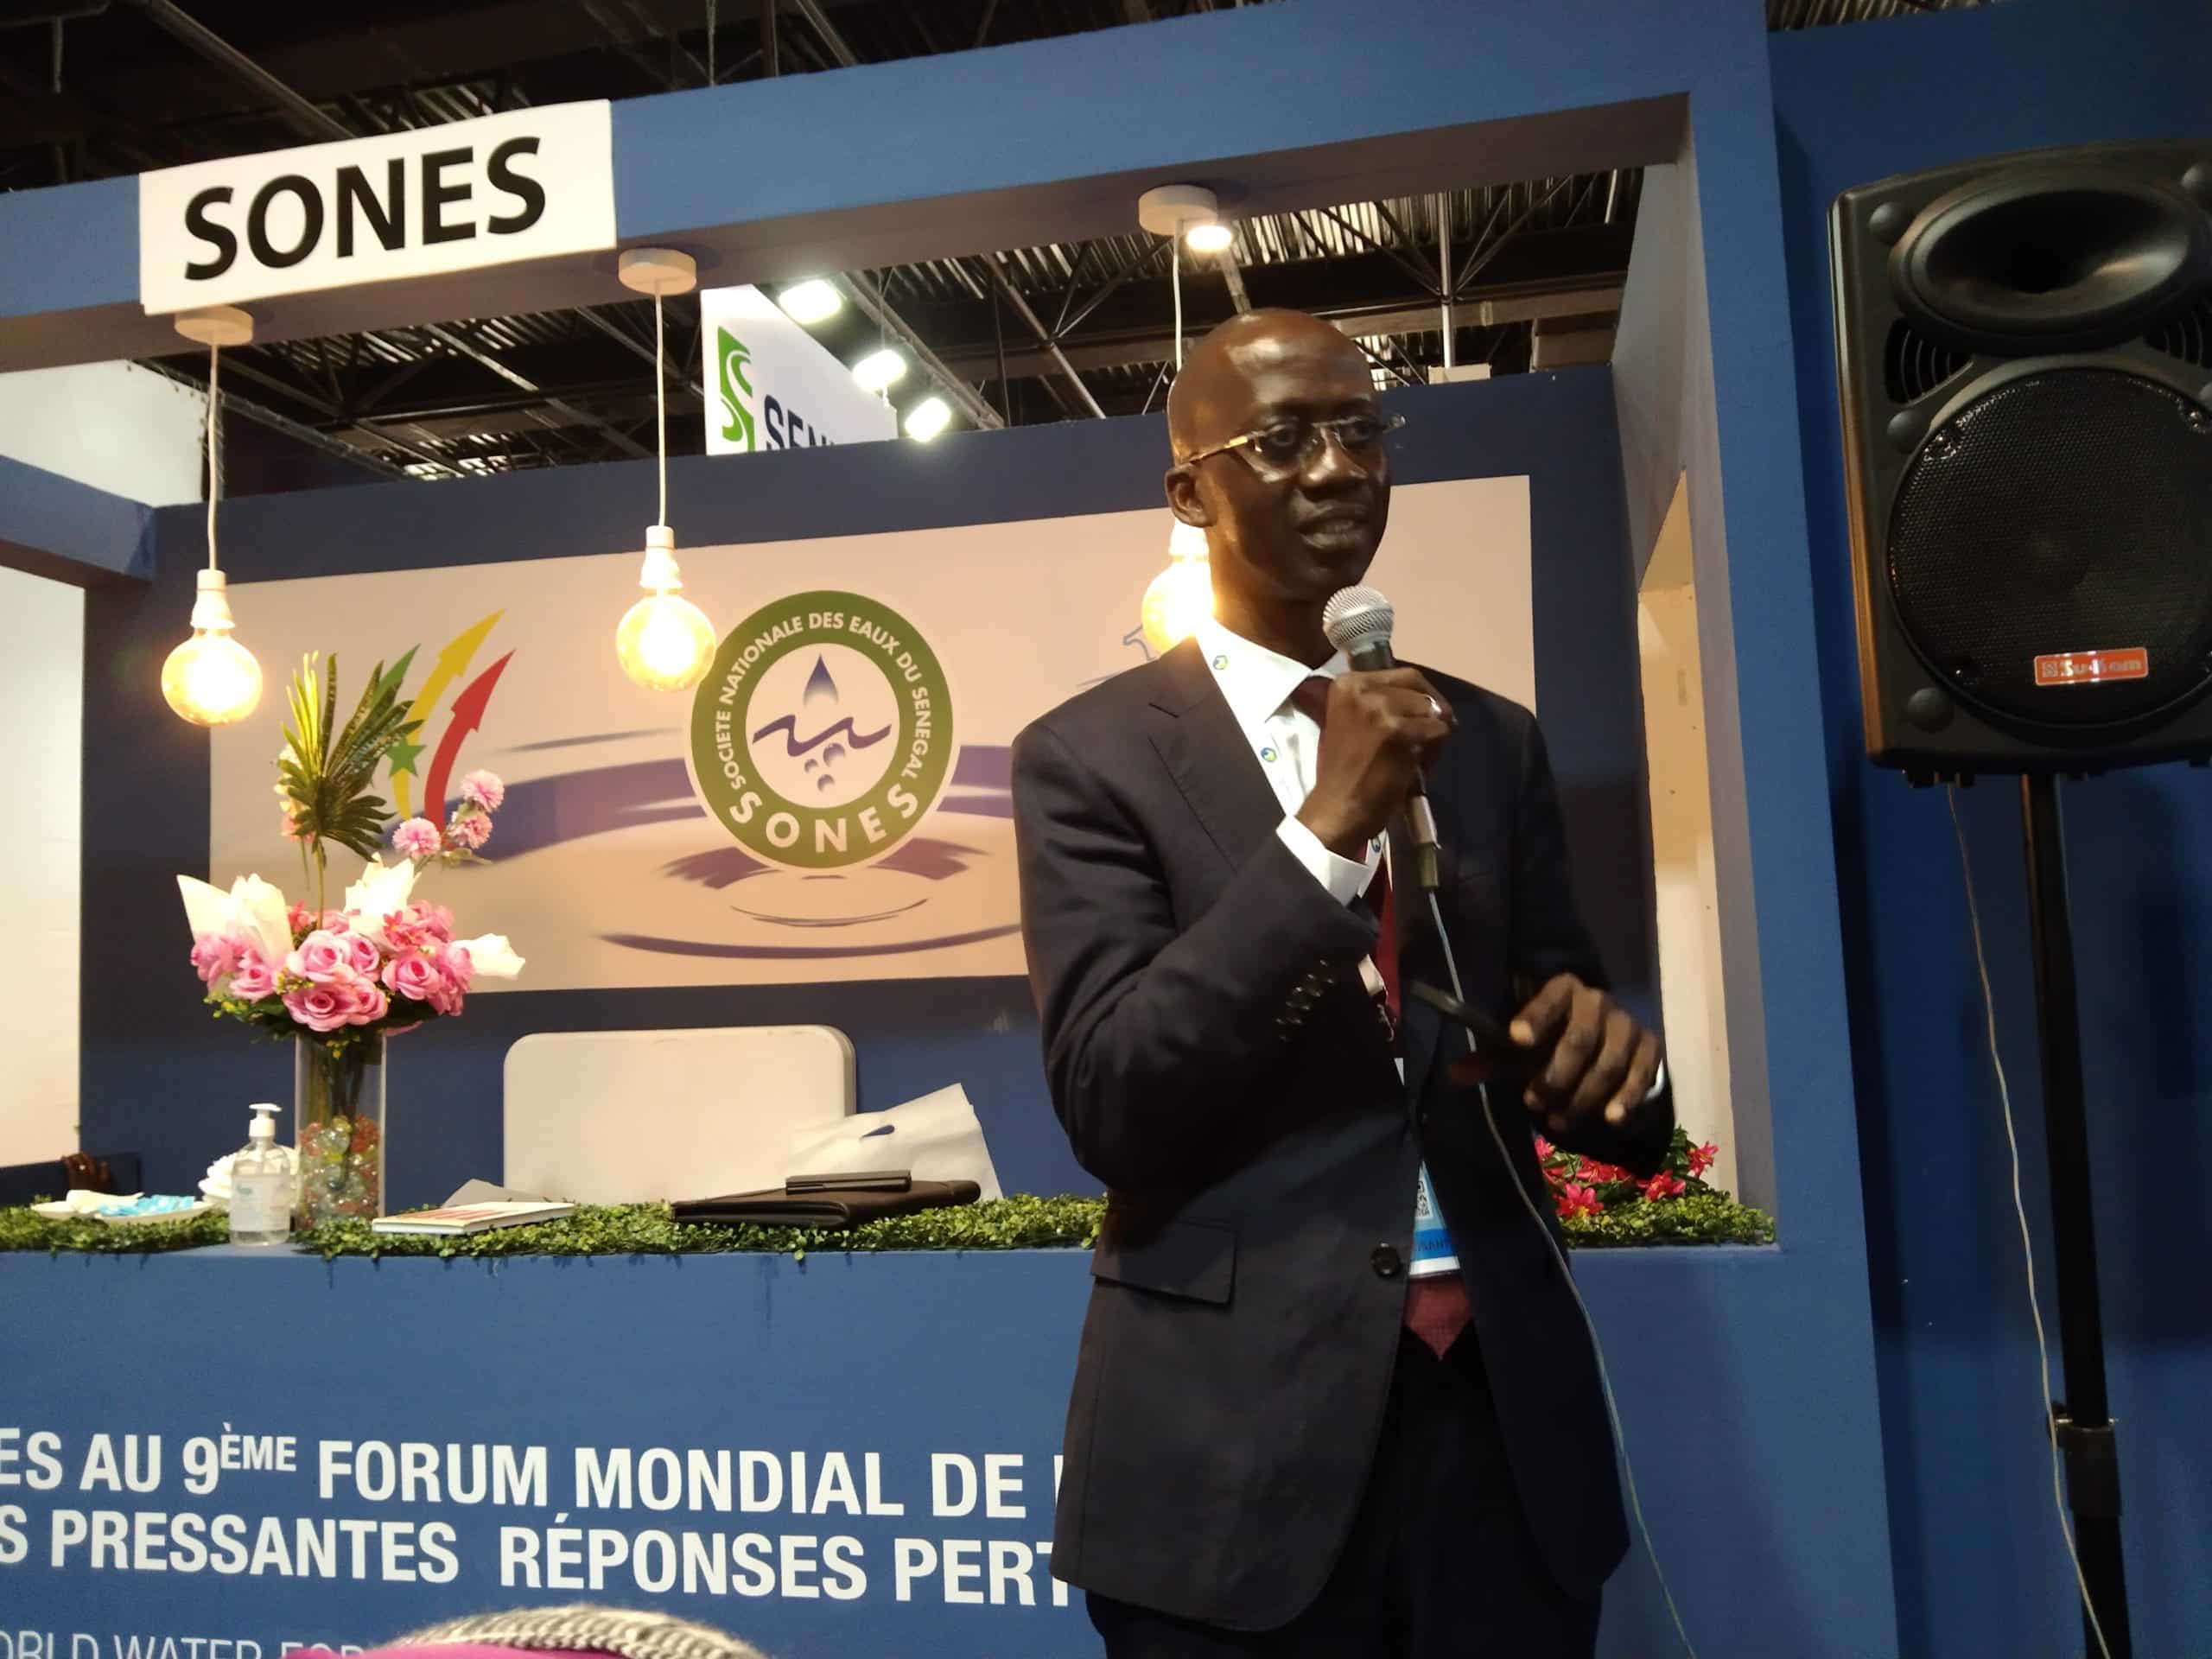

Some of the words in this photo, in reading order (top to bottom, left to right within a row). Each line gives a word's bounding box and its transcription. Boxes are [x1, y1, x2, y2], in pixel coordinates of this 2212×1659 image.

[185, 137, 545, 281] SONES
[719, 616, 804, 704] NATIONALE
[809, 613, 844, 630] DES
[849, 616, 900, 655] EAUX
[896, 652, 922, 682] DU
[715, 710, 746, 790] SOCIETE
[901, 687, 931, 779] SENEGAL
[729, 784, 918, 854] SONES
[79, 1433, 162, 1492] AU
[183, 1422, 297, 1495] 9ÈME
[319, 1440, 548, 1507] FORUM
[575, 1447, 905, 1516] MONDIAL
[931, 1453, 1027, 1519] DE
[51, 1509, 460, 1584] PRESSANTES
[499, 1512, 868, 1600] RÉPONSES
